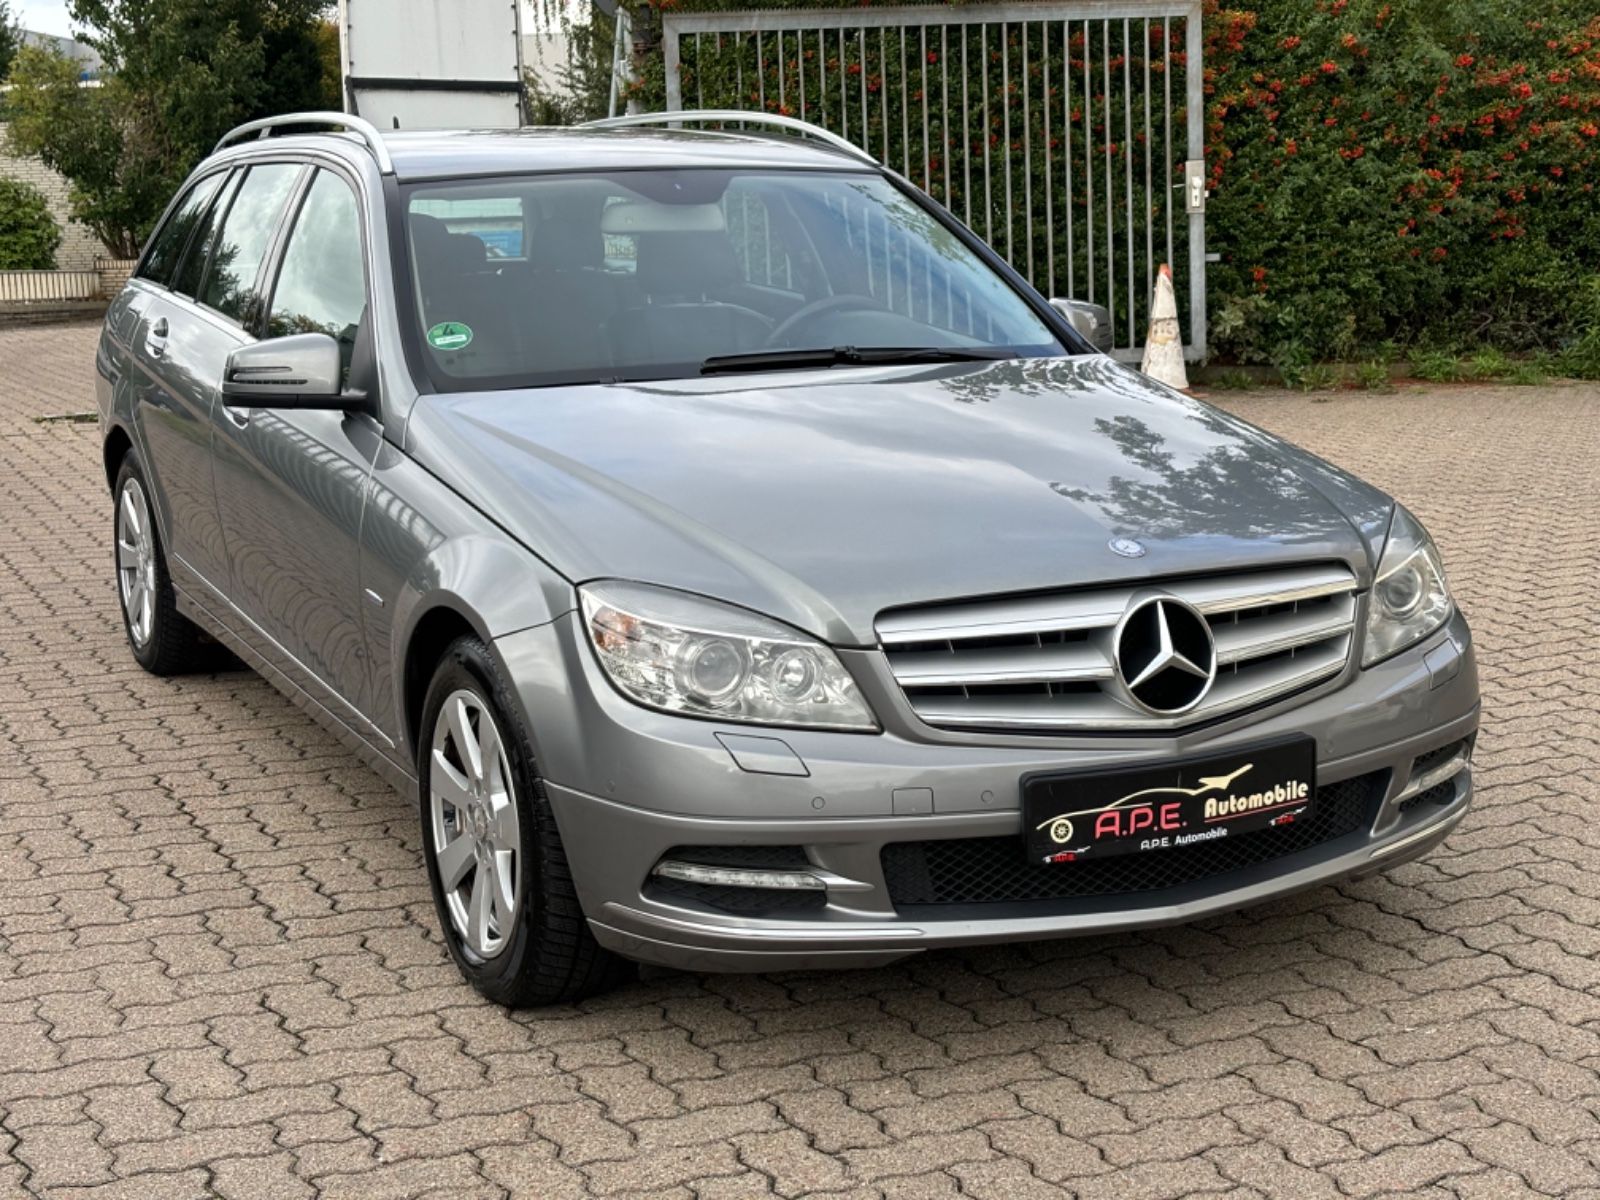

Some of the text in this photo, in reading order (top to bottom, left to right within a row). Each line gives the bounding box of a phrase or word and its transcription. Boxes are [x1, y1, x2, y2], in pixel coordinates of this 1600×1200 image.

[1095, 780, 1309, 839] A.P.E. Automobile
[1175, 827, 1228, 845] Automobile
